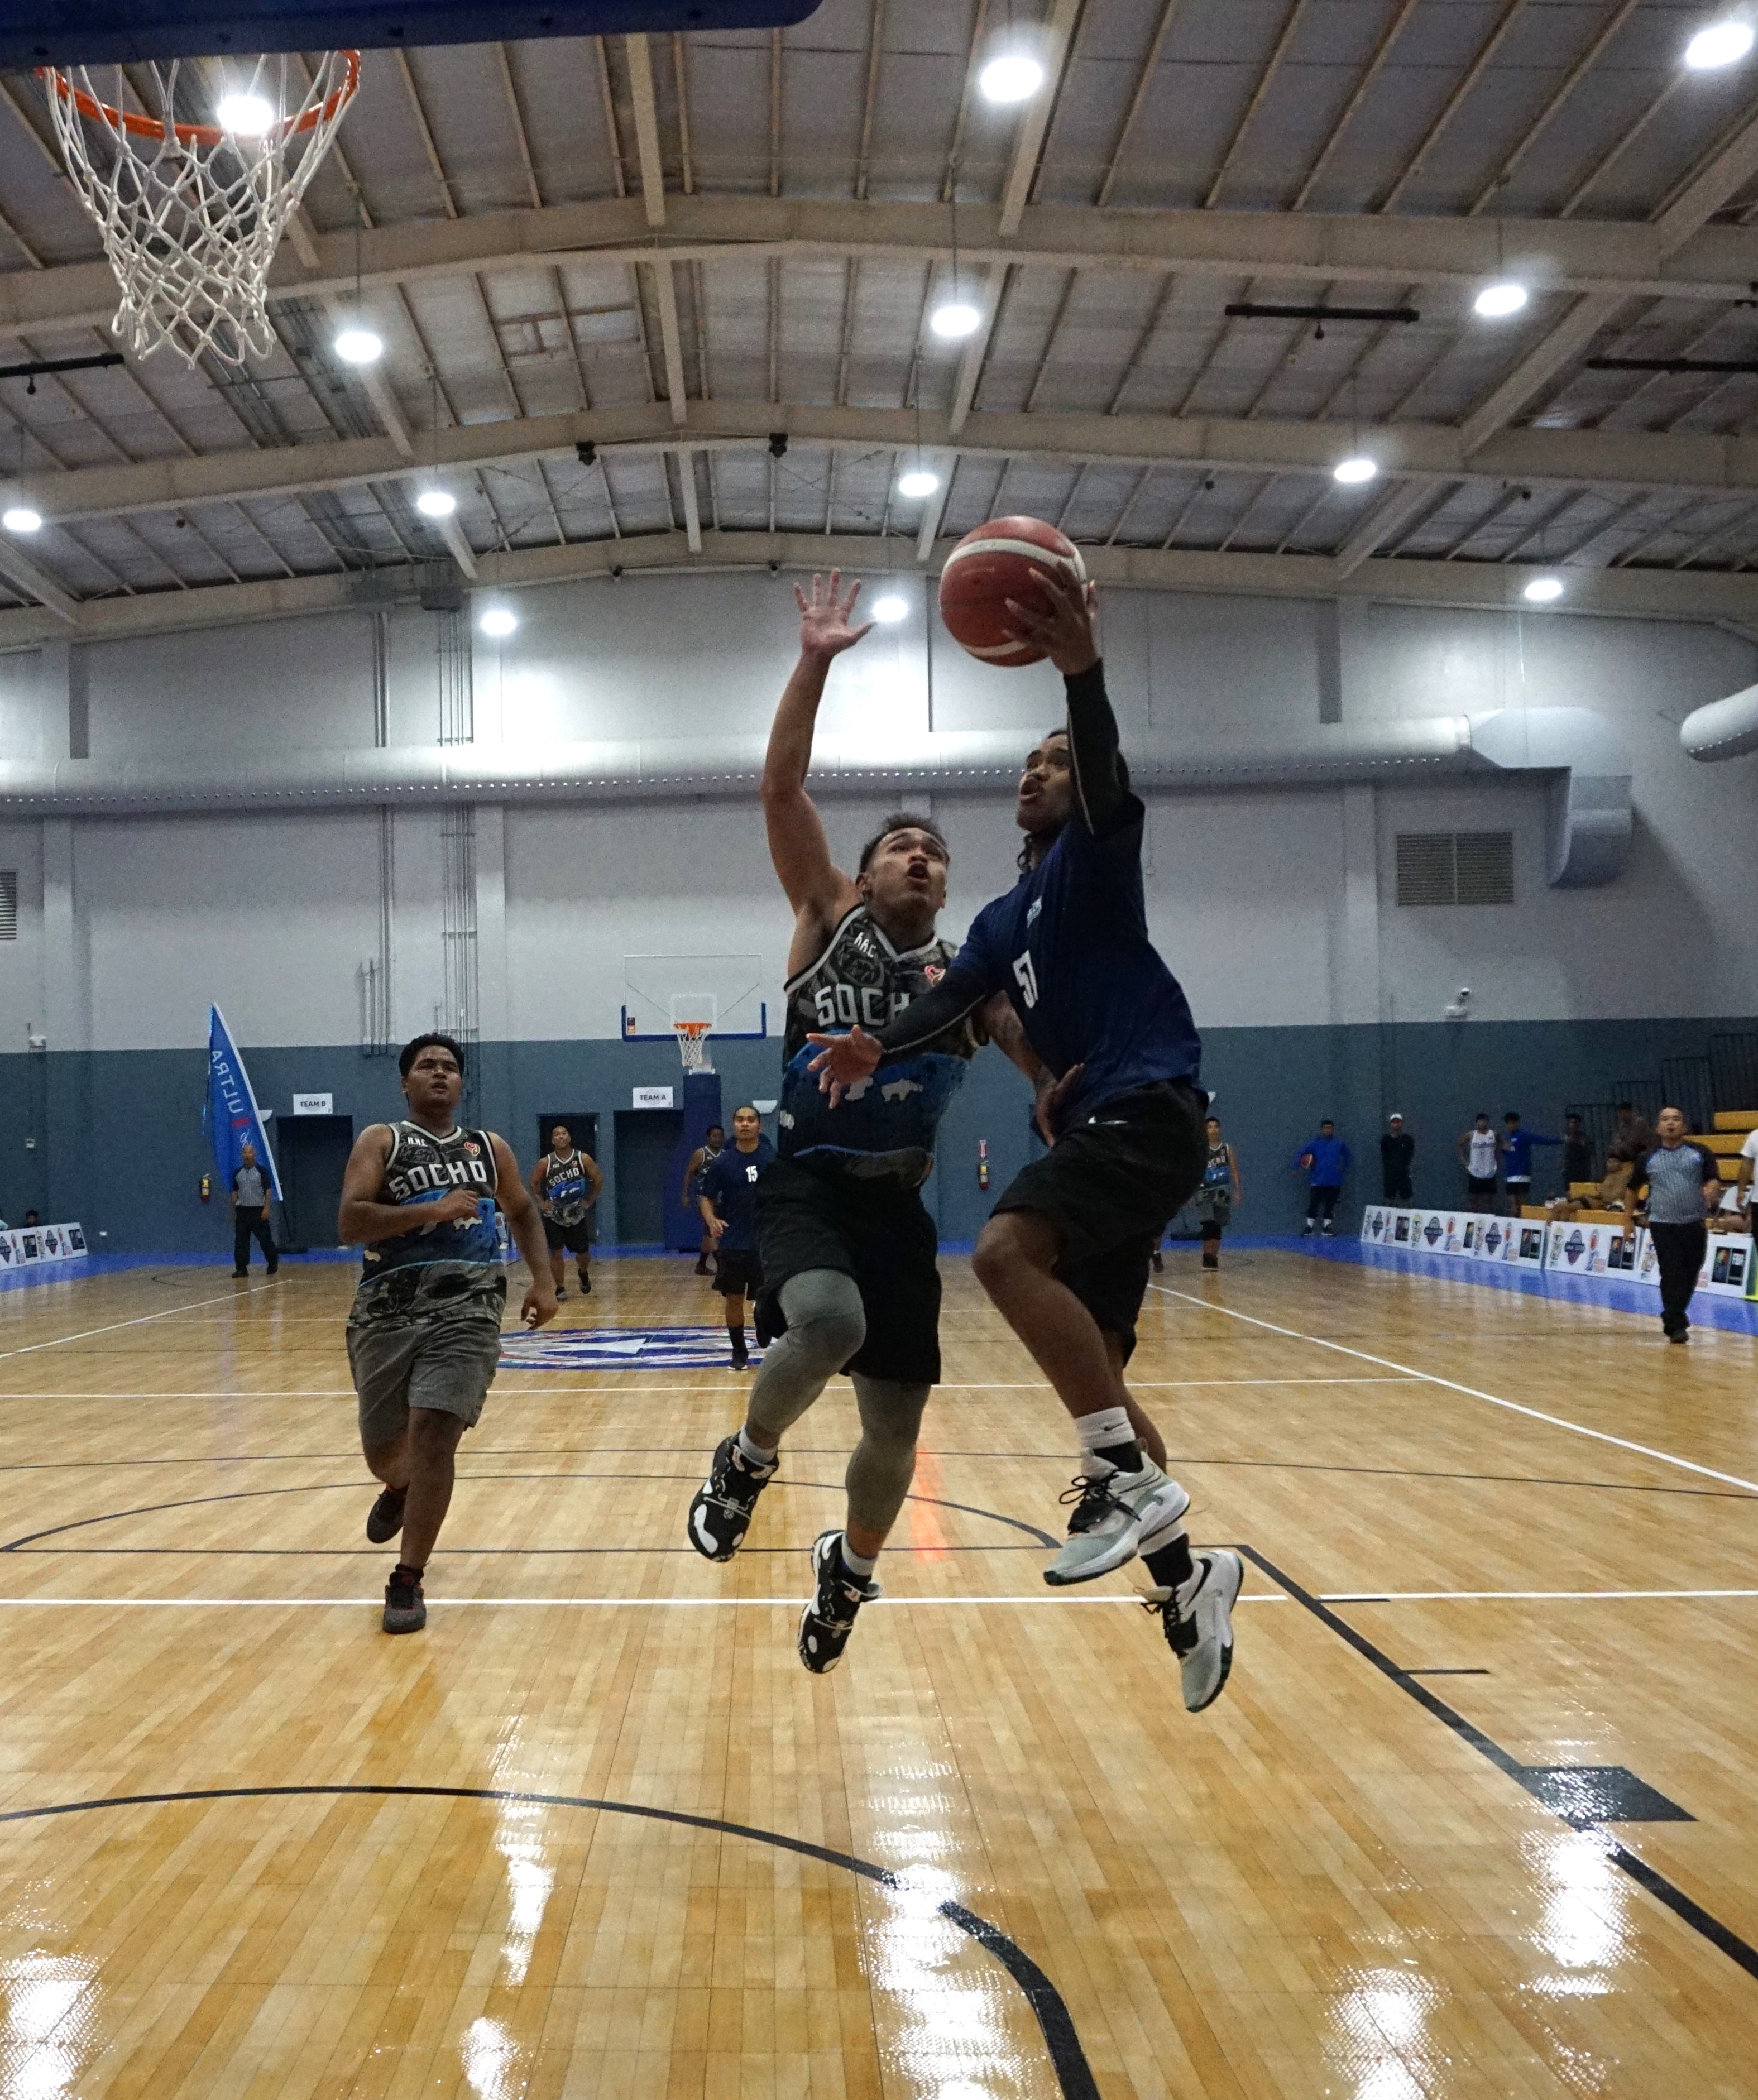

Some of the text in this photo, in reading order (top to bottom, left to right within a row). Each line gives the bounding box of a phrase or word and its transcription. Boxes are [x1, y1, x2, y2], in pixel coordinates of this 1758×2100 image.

[815, 983, 911, 1027] SOCH
[389, 1161, 487, 1200] SOCHO
[549, 1167, 579, 1186] SOCHO
[746, 1166, 758, 1182] 15
